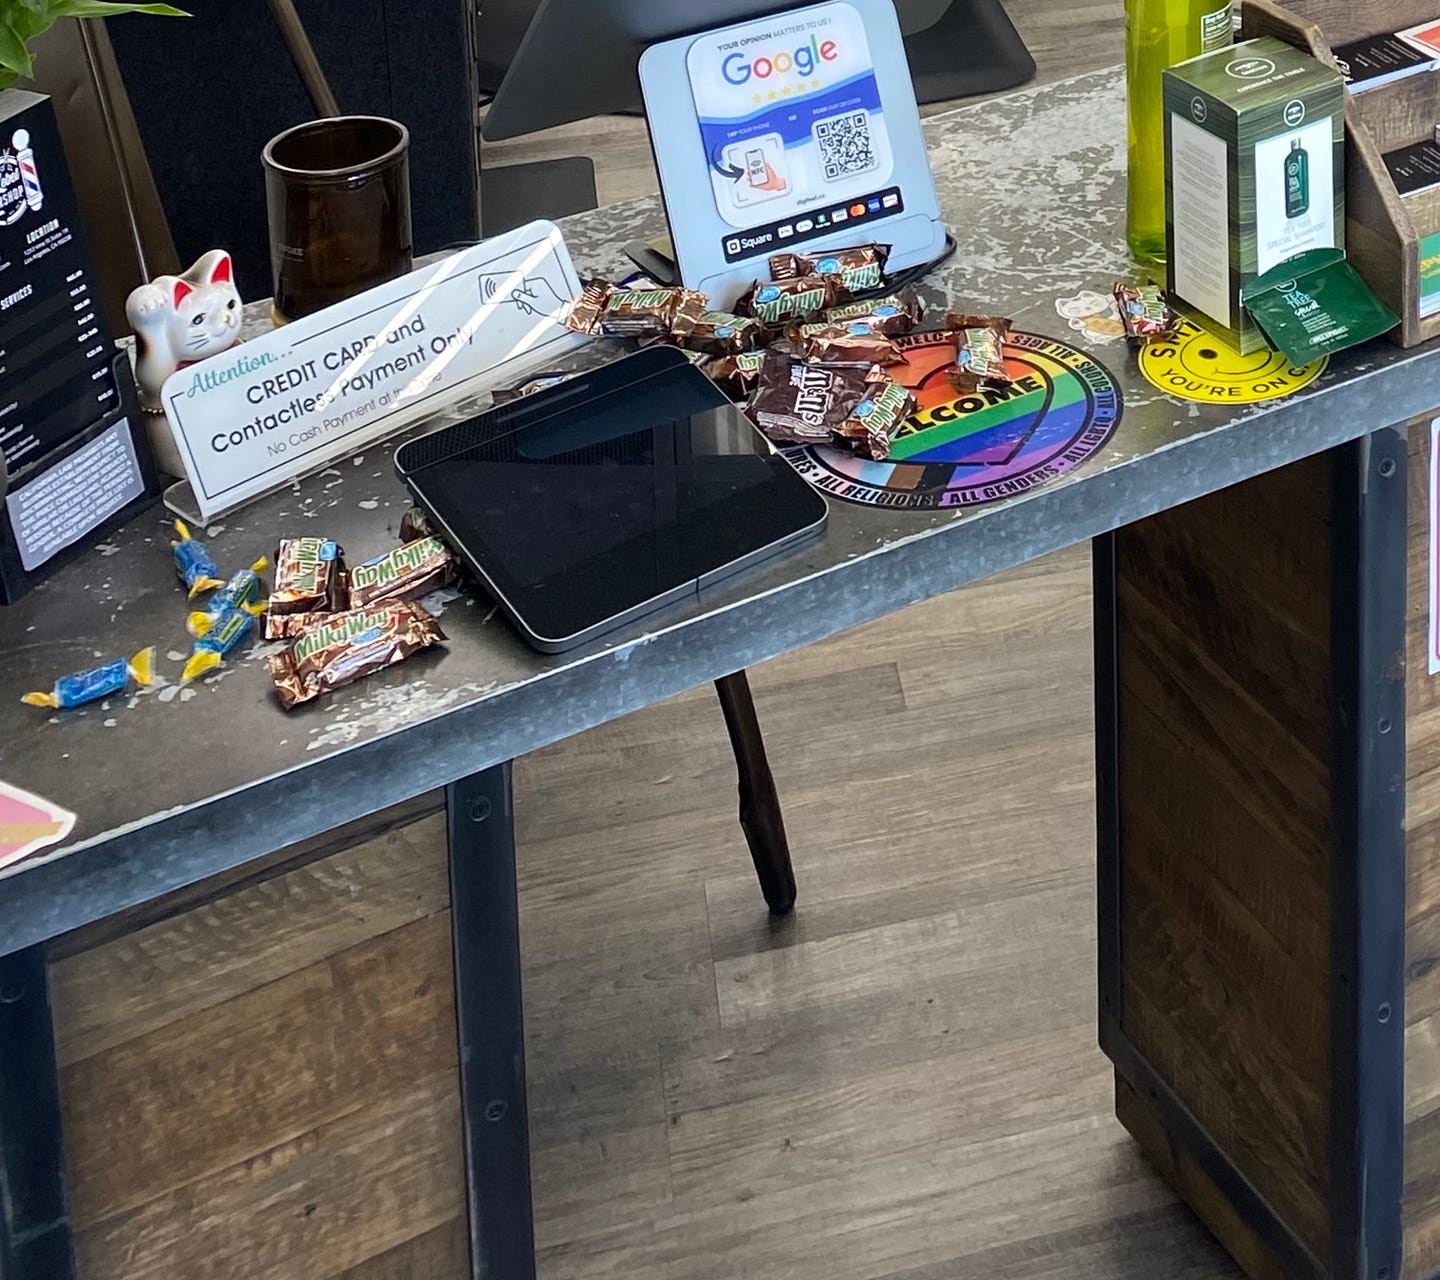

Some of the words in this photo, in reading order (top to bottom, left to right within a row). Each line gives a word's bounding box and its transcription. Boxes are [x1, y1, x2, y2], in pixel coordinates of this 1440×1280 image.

[717, 39, 738, 51] YOUR
[740, 32, 772, 48] OPINION
[773, 24, 805, 38] MATTERS
[806, 22, 816, 31] TO
[817, 19, 827, 28] US
[721, 33, 838, 85] Google
[741, 232, 773, 249] Square
[0, 284, 33, 311] SERVICES
[1011, 335, 1049, 351] AGES
[246, 361, 319, 405] CREDIT
[385, 315, 426, 345] and
[1075, 360, 1112, 393] COLORS
[1161, 368, 1243, 396] YOU'RE
[1252, 377, 1289, 394] ON
[267, 443, 287, 458] No
[288, 423, 322, 448] Cash
[323, 399, 377, 431] Payment
[378, 392, 391, 405] at
[814, 475, 841, 492] ALL
[950, 488, 980, 505] ALL
[982, 464, 1059, 501] GENDERS
